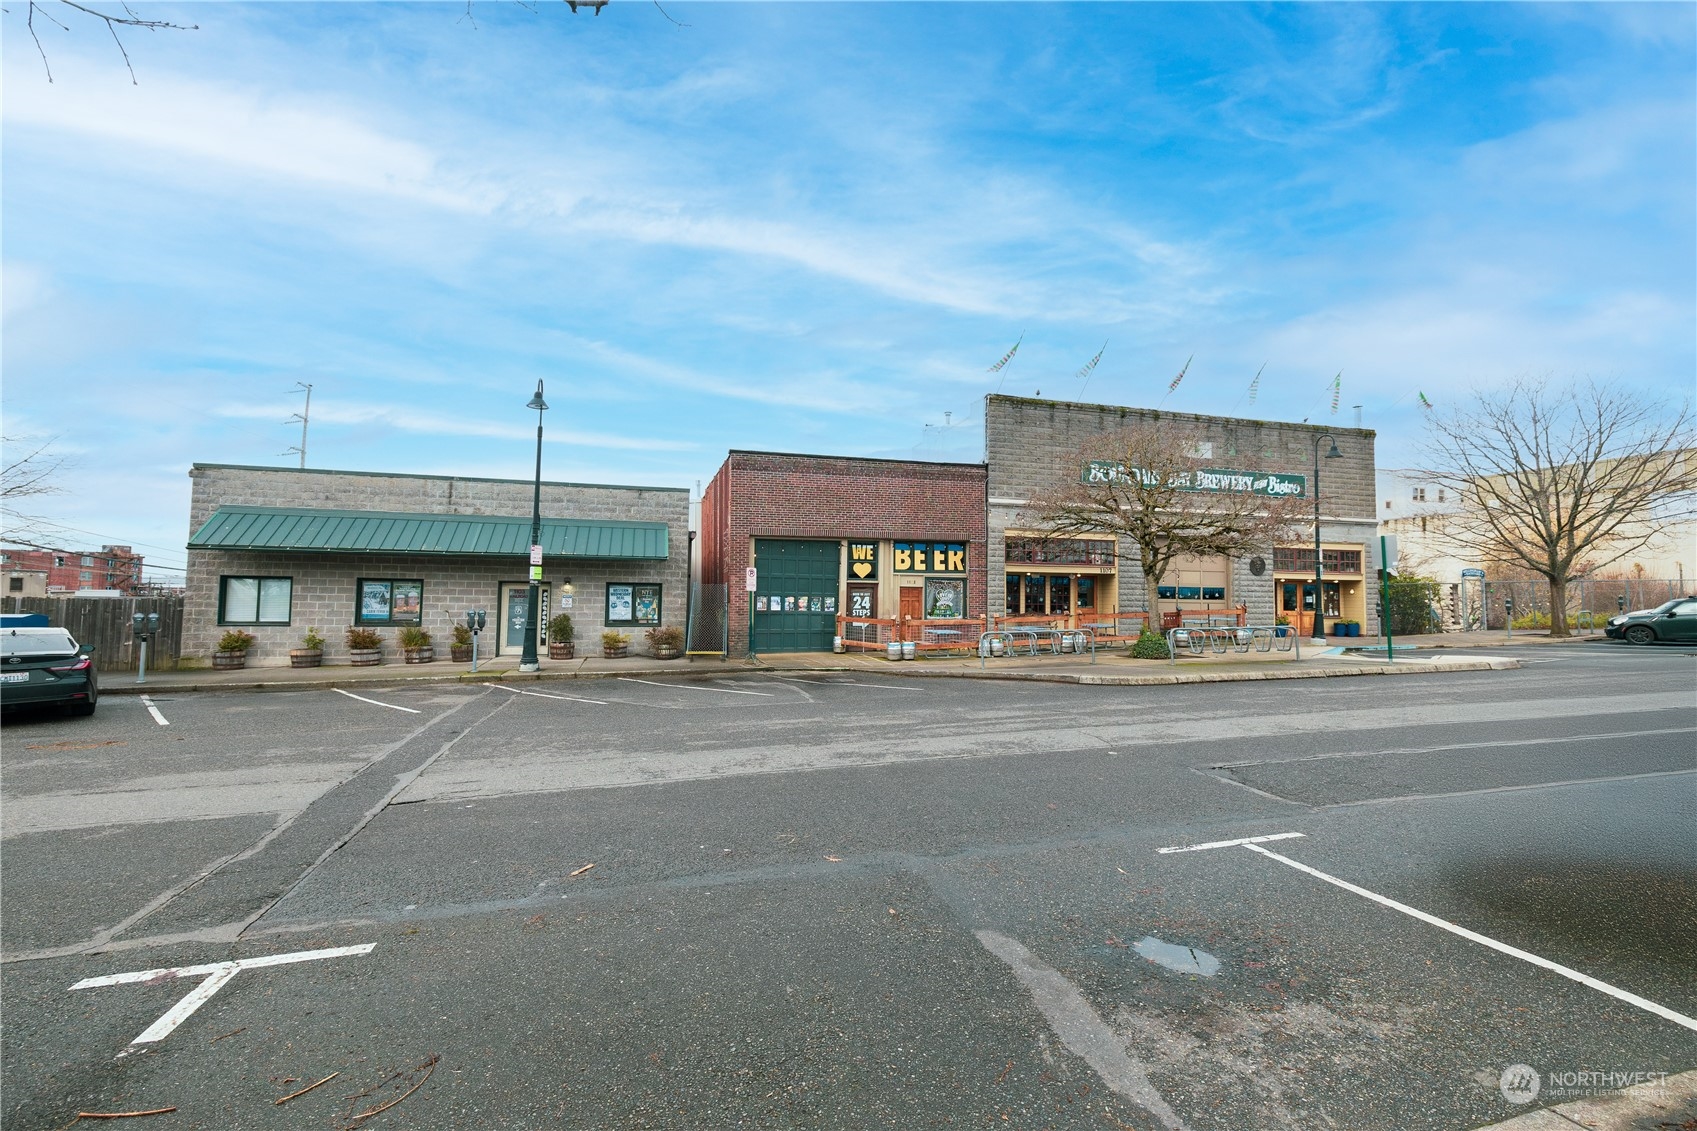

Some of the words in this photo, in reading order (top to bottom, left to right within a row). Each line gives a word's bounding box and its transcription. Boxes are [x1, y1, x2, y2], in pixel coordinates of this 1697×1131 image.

[1196, 471, 1253, 491] BREWERY
[1267, 476, 1301, 494] Bistro
[852, 544, 874, 560] WE
[894, 543, 964, 571] BEER
[853, 596, 870, 609] 24
